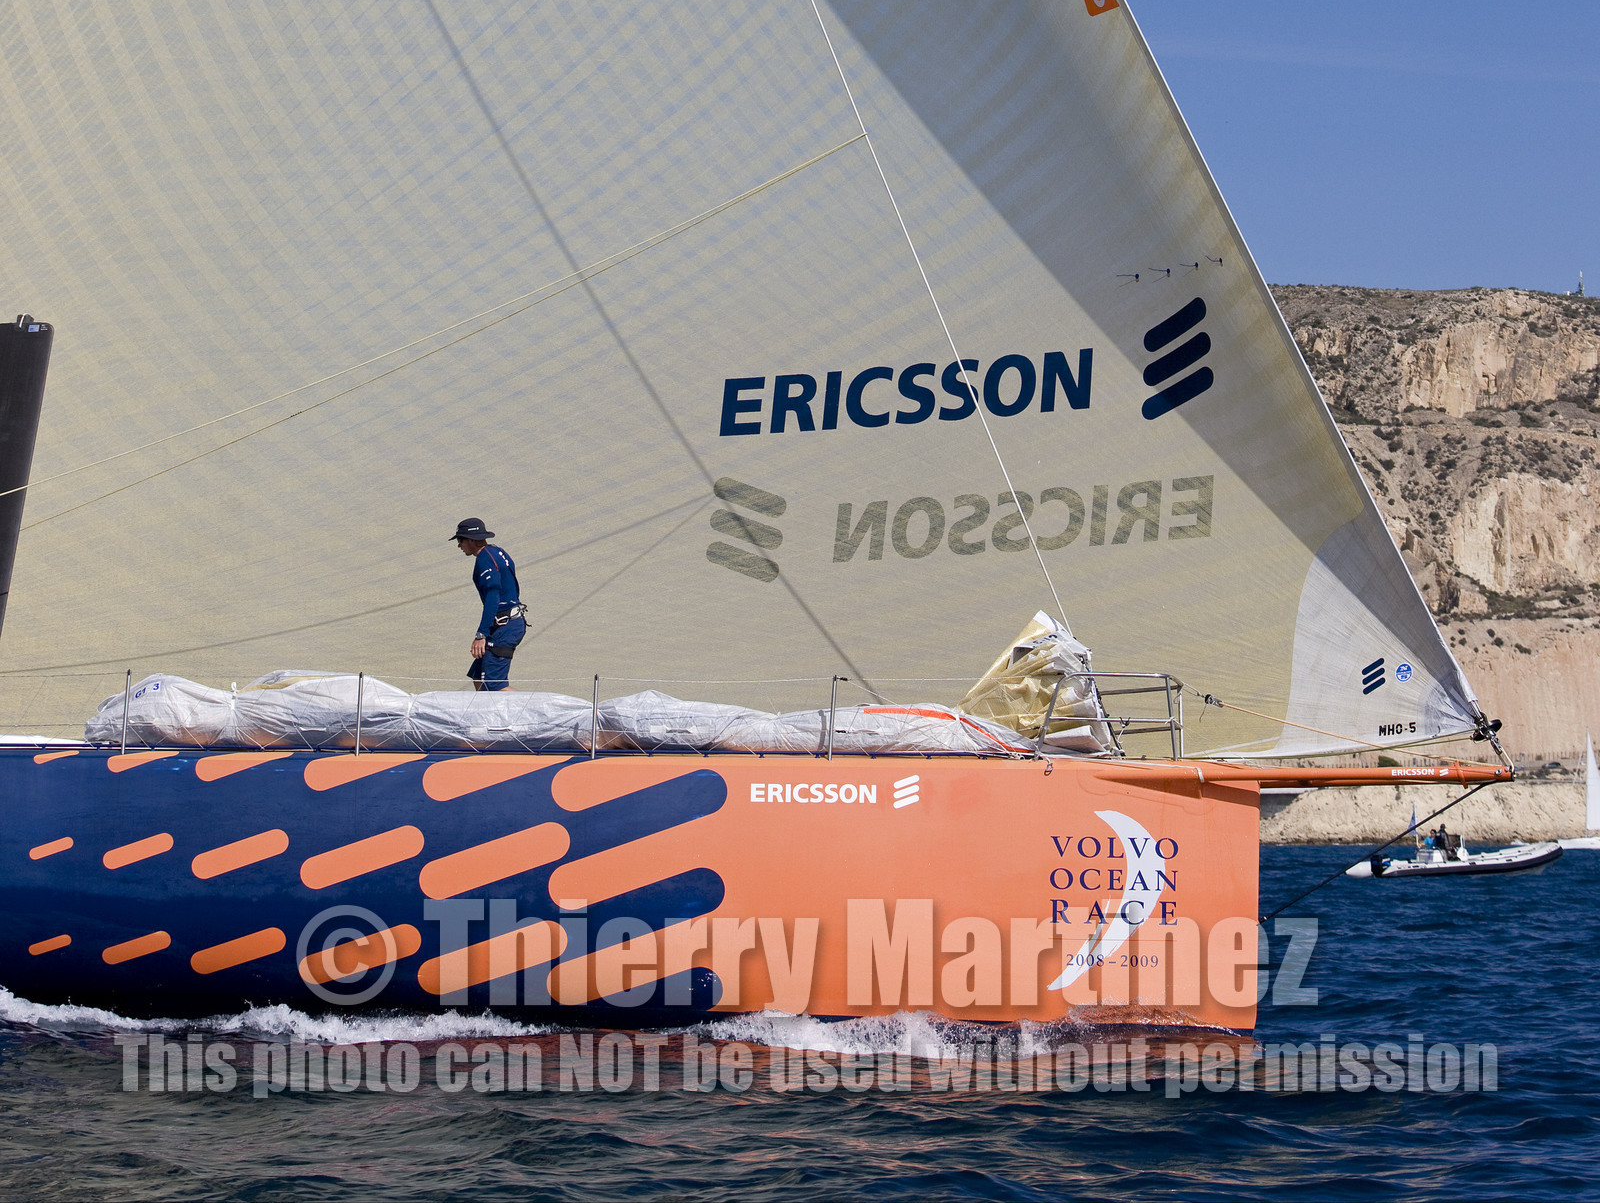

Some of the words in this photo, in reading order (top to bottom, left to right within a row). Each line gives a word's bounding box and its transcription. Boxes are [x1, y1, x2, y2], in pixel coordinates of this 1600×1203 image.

[719, 348, 1093, 436] ERICSSON
[1391, 768, 1435, 776] ERICSSON
[750, 782, 877, 804] ERICSSON
[1050, 835, 1180, 860] VOLVO
[1049, 867, 1179, 892] OCEAN
[1050, 898, 1179, 926] RACE
